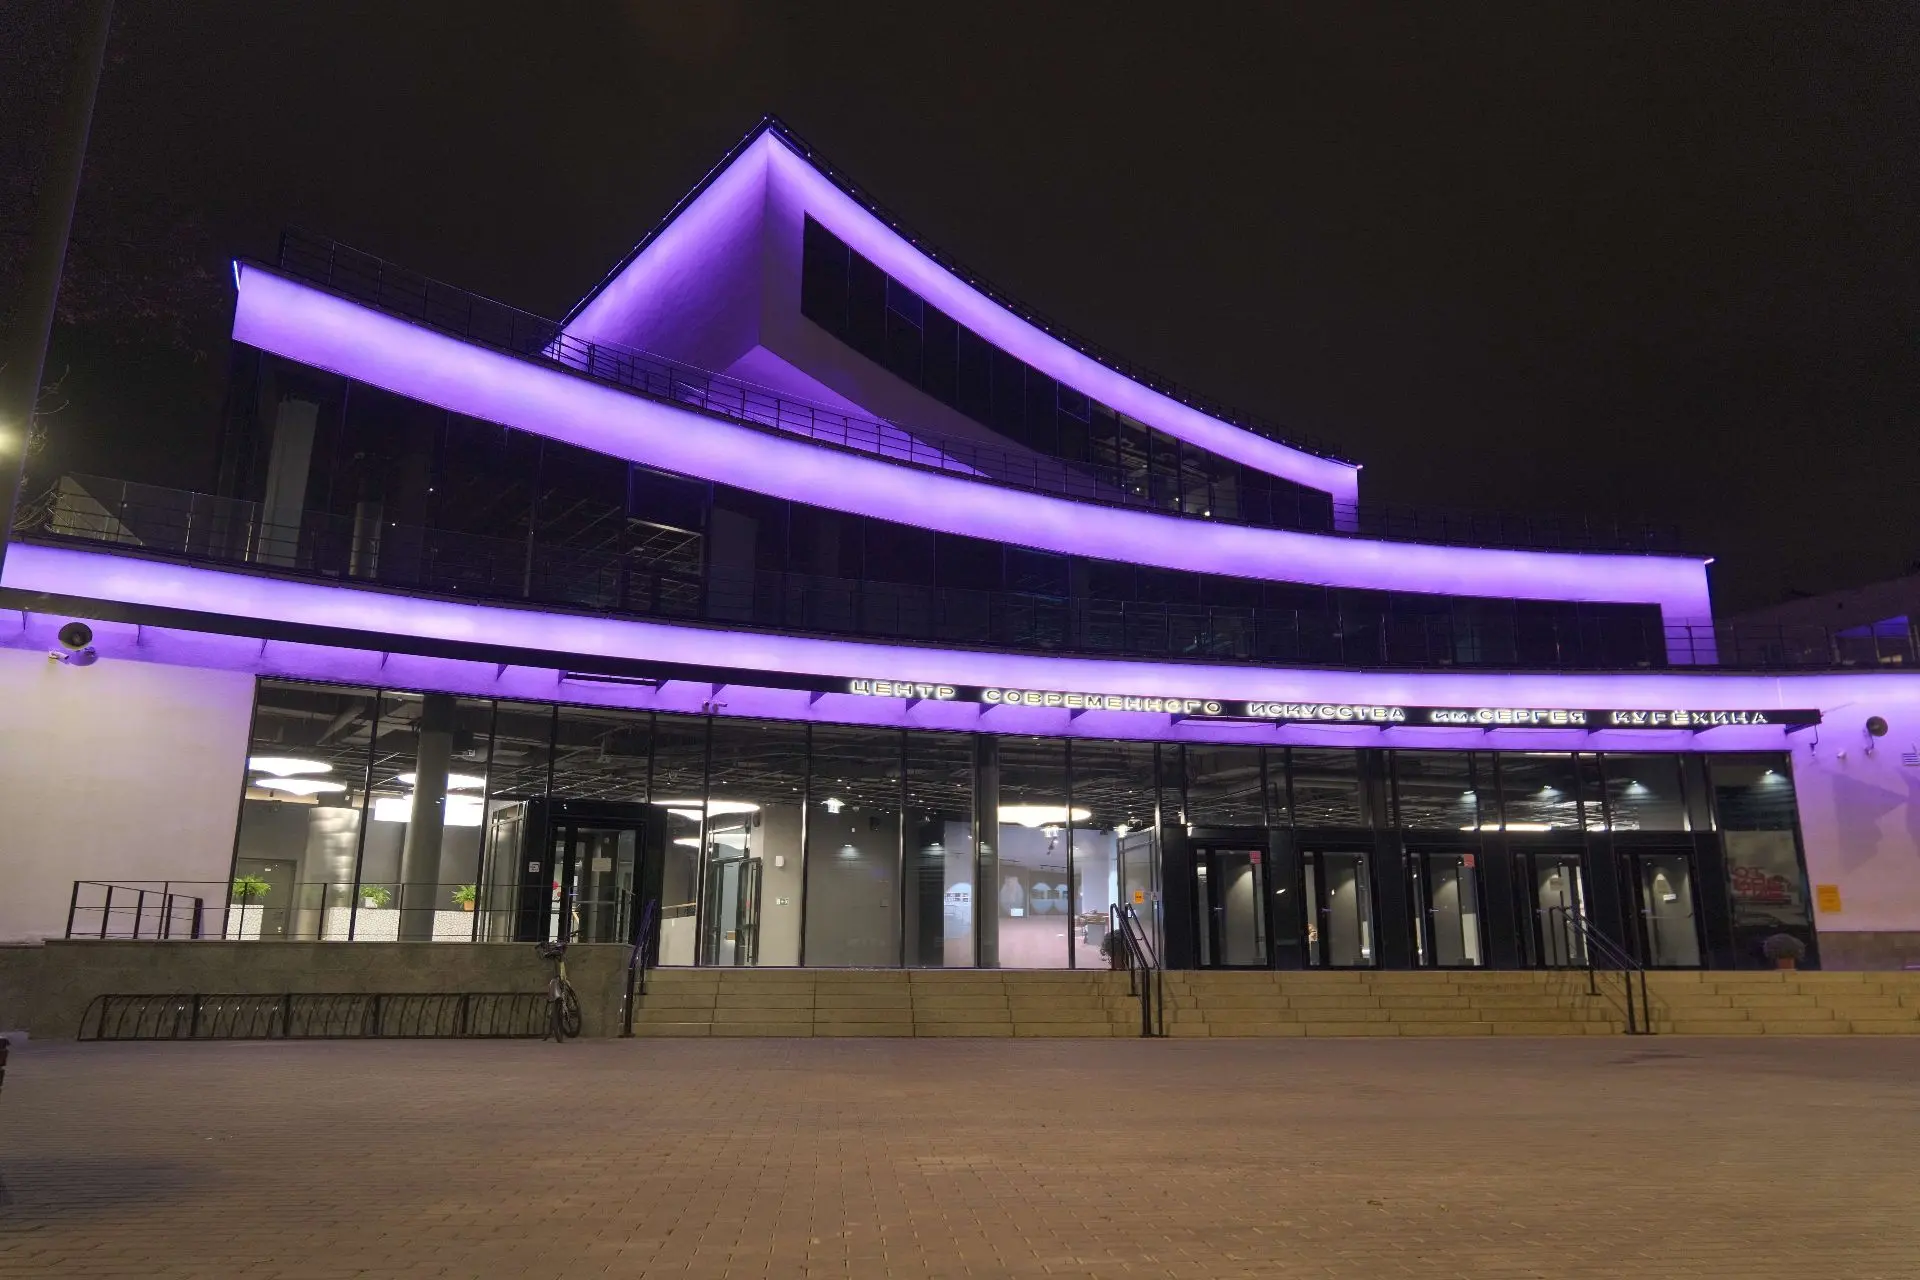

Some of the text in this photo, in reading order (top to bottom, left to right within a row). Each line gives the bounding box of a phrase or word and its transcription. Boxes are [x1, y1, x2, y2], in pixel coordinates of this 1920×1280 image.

[852, 679, 956, 699] ЦЕНТР
[984, 689, 1222, 713] СОВРЕМЕННОГО
[1250, 702, 1405, 721] ИСКУССТВА
[1611, 709, 1768, 725] КУРЁХИНА
